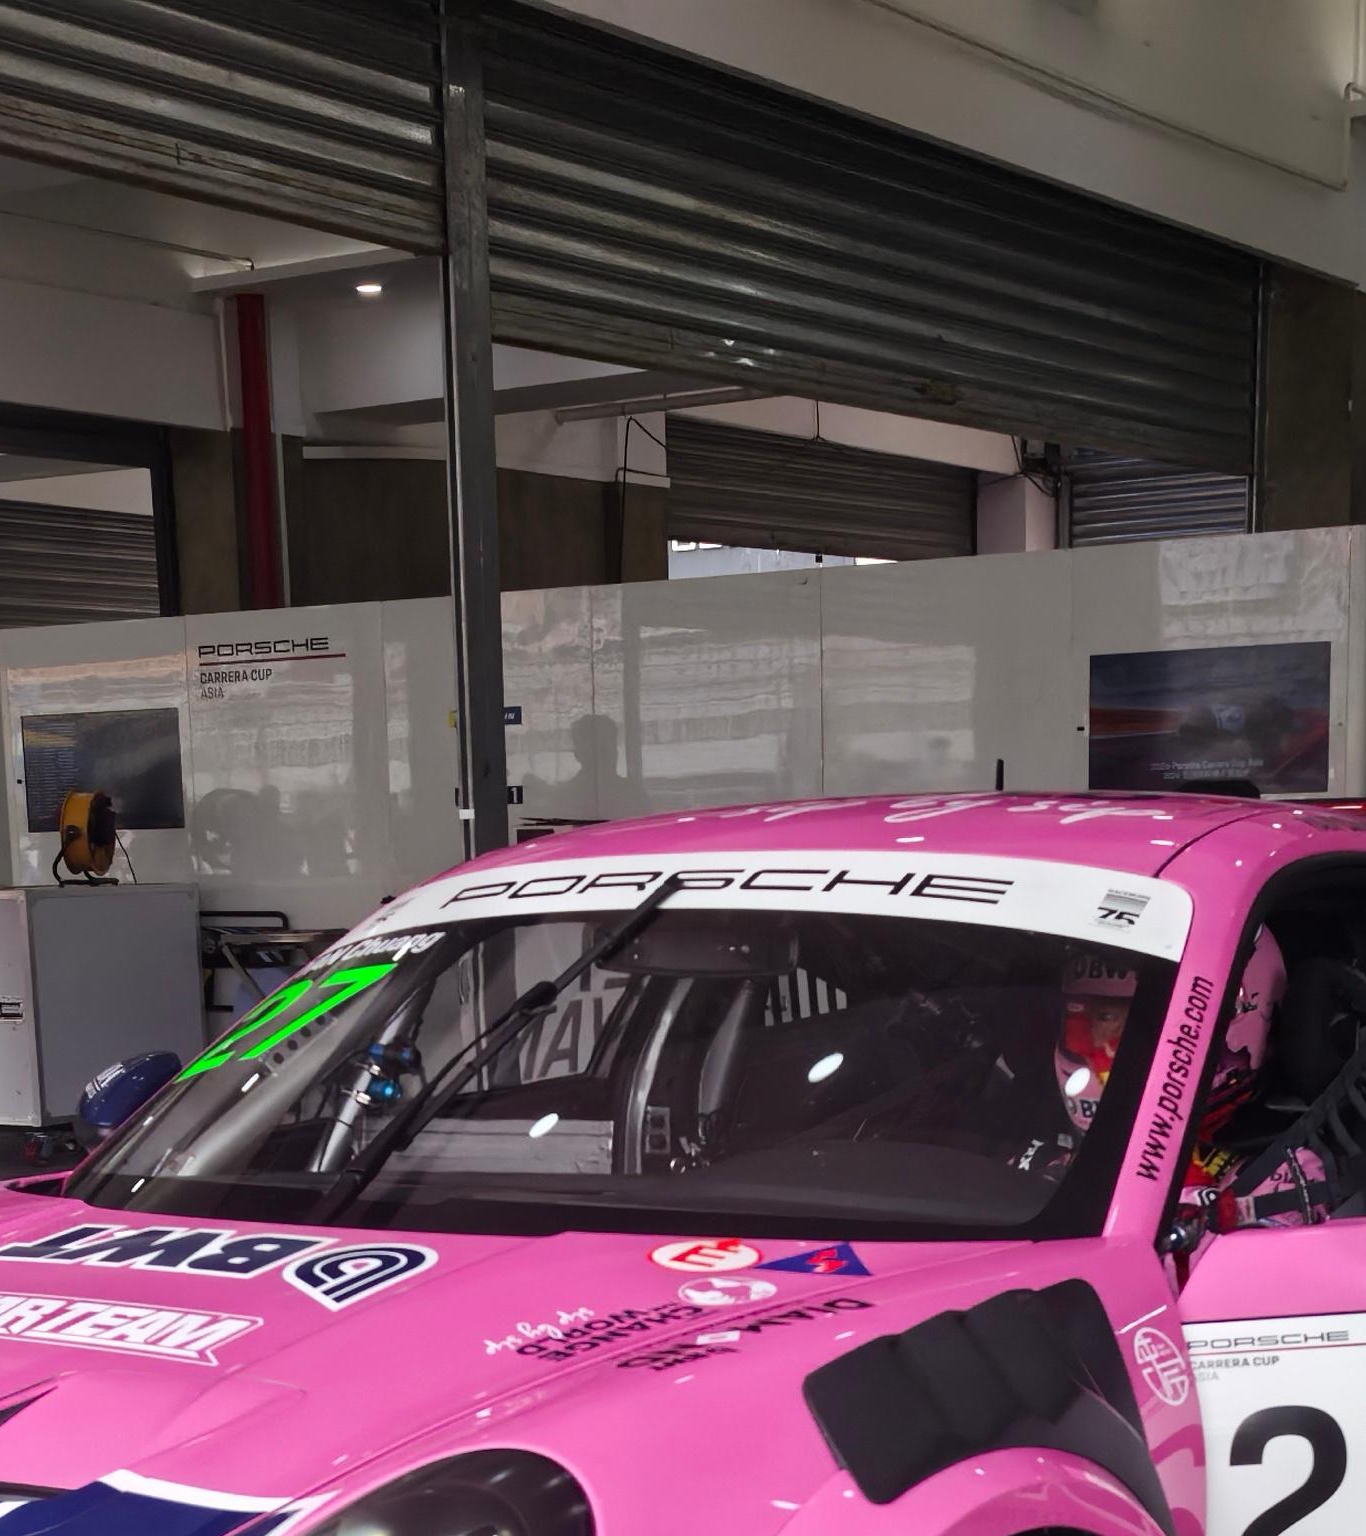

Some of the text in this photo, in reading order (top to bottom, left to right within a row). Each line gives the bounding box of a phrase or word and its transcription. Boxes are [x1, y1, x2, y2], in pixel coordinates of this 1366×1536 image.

[198, 637, 330, 658] PORSCHE
[200, 668, 273, 685] CARRERA CUP
[201, 686, 225, 700] ASIA
[439, 867, 1015, 909] PORSCHE
[173, 962, 399, 1083] 27
[1137, 975, 1214, 1182] www.porsche.com
[1186, 1330, 1350, 1350] PORSCHE
[1190, 1355, 1280, 1371] CARRERA CUP
[1195, 1371, 1220, 1383] SIA
